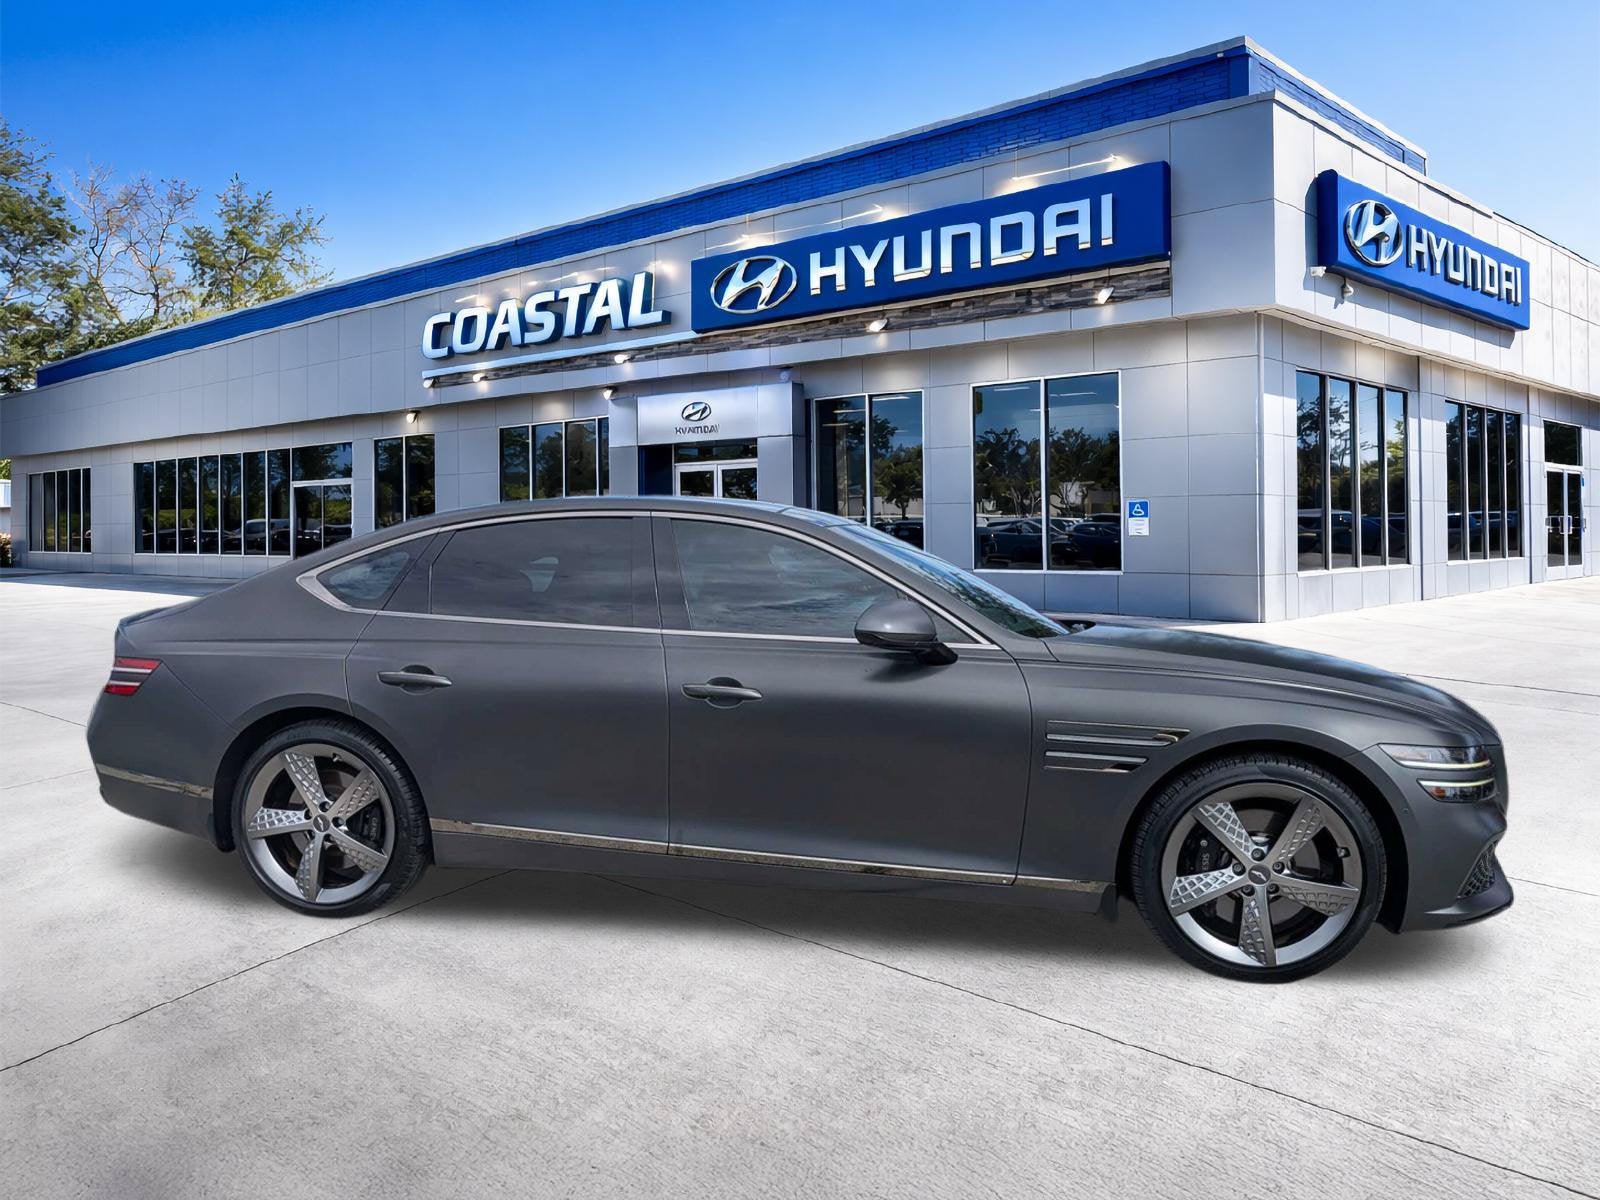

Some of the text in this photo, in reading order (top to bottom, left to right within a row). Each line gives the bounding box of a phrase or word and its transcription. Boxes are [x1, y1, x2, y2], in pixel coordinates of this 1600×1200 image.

[809, 193, 1114, 296] HYUNDAI
[1406, 223, 1522, 306] HYUNDAI
[422, 271, 671, 359] COASTAL
